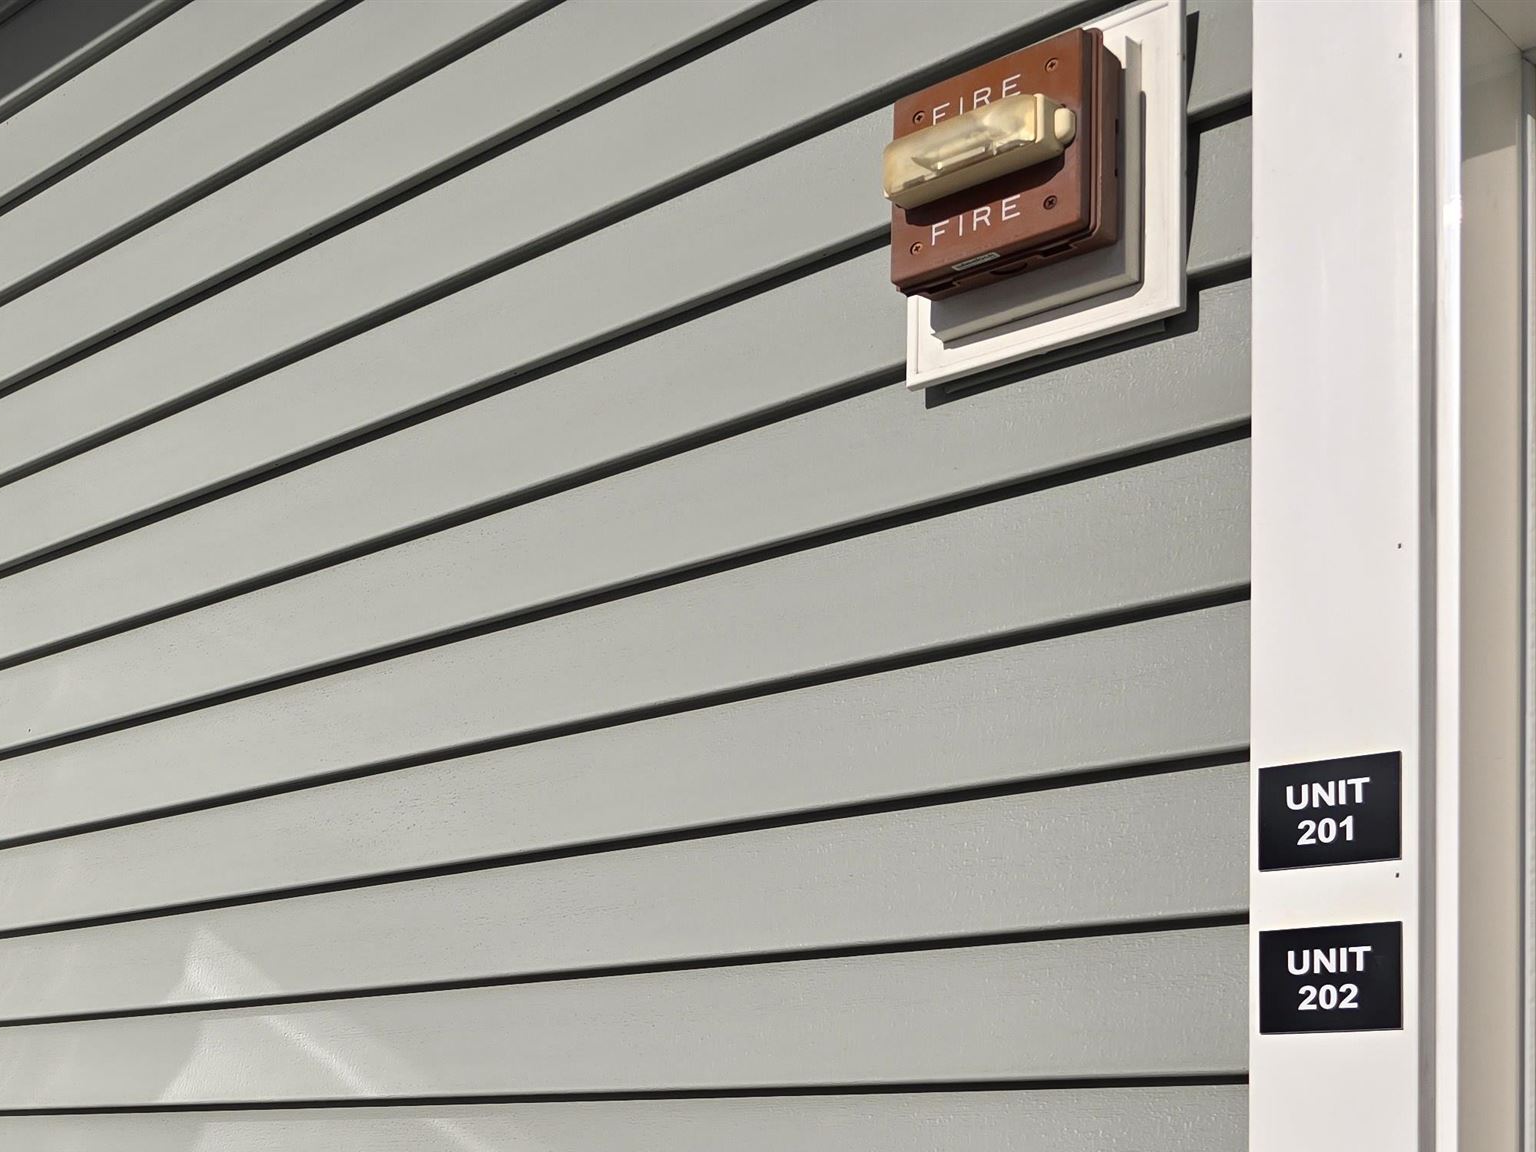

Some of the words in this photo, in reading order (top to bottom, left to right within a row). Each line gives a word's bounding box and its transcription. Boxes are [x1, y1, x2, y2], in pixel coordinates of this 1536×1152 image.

[932, 73, 1022, 126] FIRE
[931, 194, 1021, 246] FIRE
[1286, 776, 1371, 811] UNIT
[1296, 815, 1355, 846] 201
[1287, 945, 1372, 976] UNIT
[1297, 983, 1360, 1011] 202
